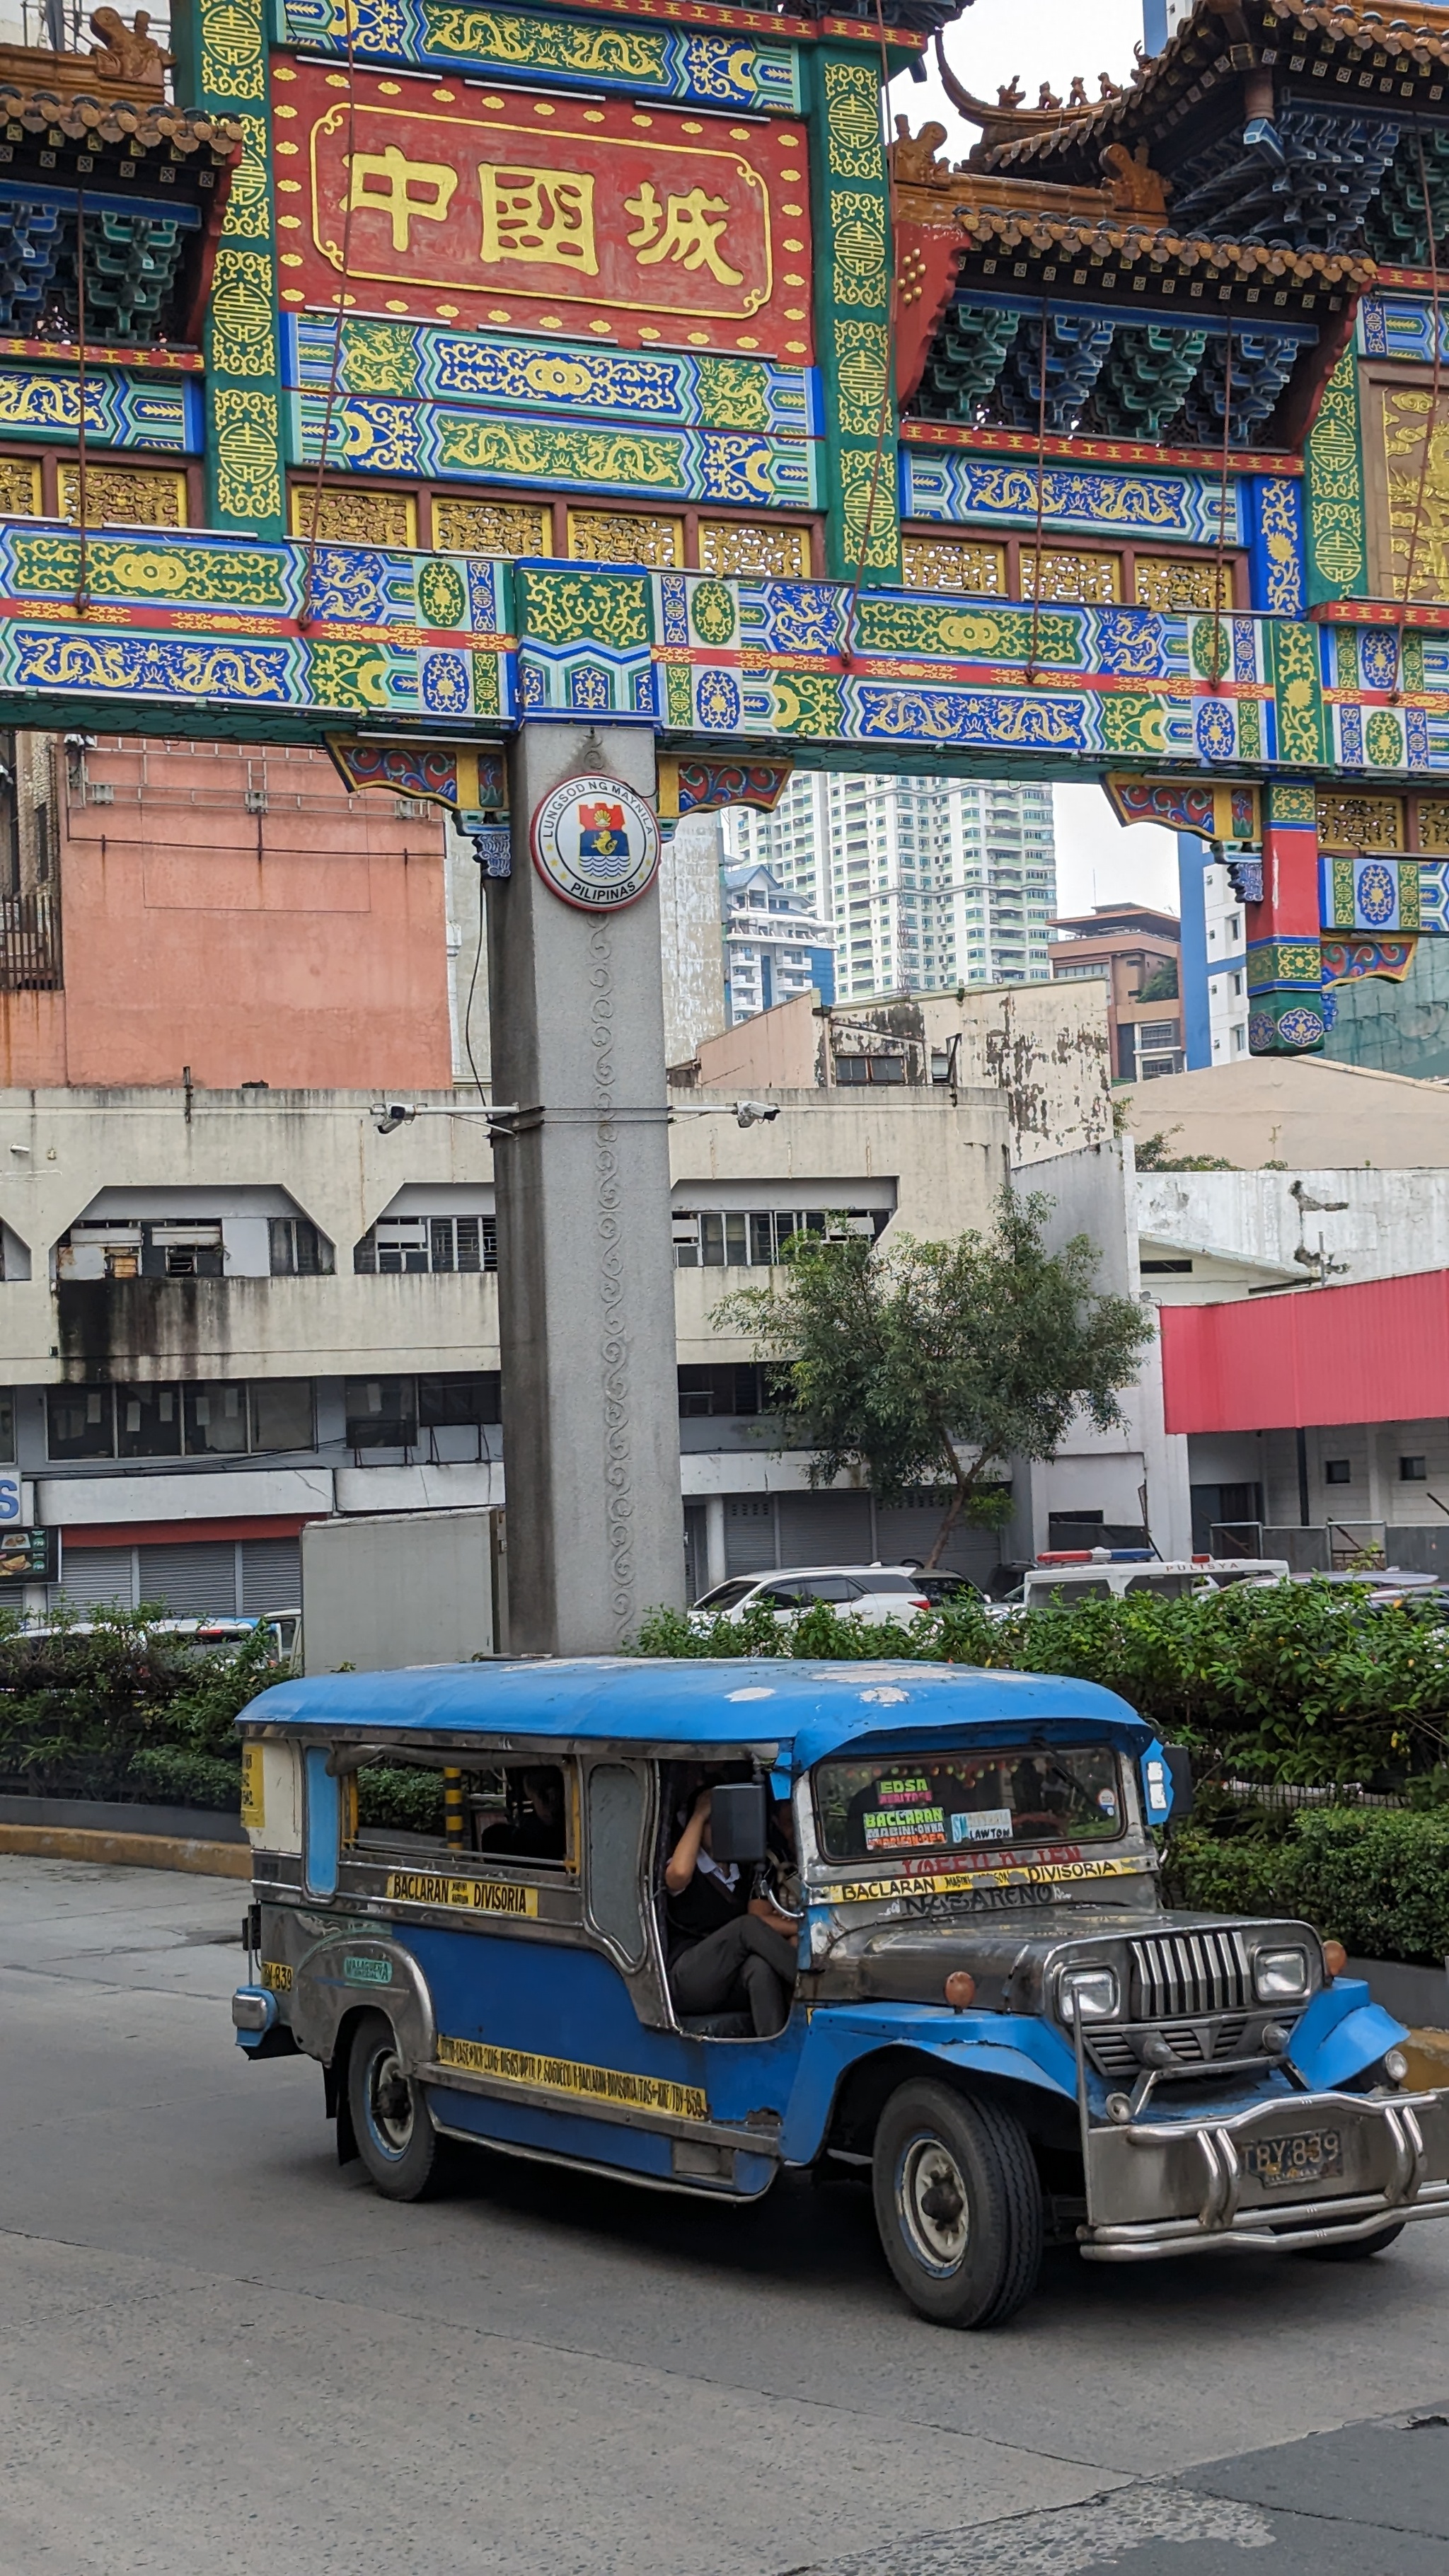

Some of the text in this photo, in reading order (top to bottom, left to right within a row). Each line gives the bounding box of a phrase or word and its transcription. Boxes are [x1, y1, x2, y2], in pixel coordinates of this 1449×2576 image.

[338, 144, 744, 286] 中國城
[543, 781, 654, 838] LUNGSOD NG MAYNILA
[570, 881, 636, 900] PILIPINAS
[1166, 1562, 1239, 1571] PULISYA
[880, 1778, 928, 1794] EDSA
[865, 1808, 943, 1827] BACLARAN
[969, 1827, 1010, 1841] LAWTON
[842, 1877, 936, 1900] BACLARAN
[1027, 1861, 1117, 1883] DIVISORIA
[393, 1875, 449, 1903] BACLARAN
[473, 1883, 526, 1914] DIVISORIA
[1293, 2133, 1339, 2166] 839
